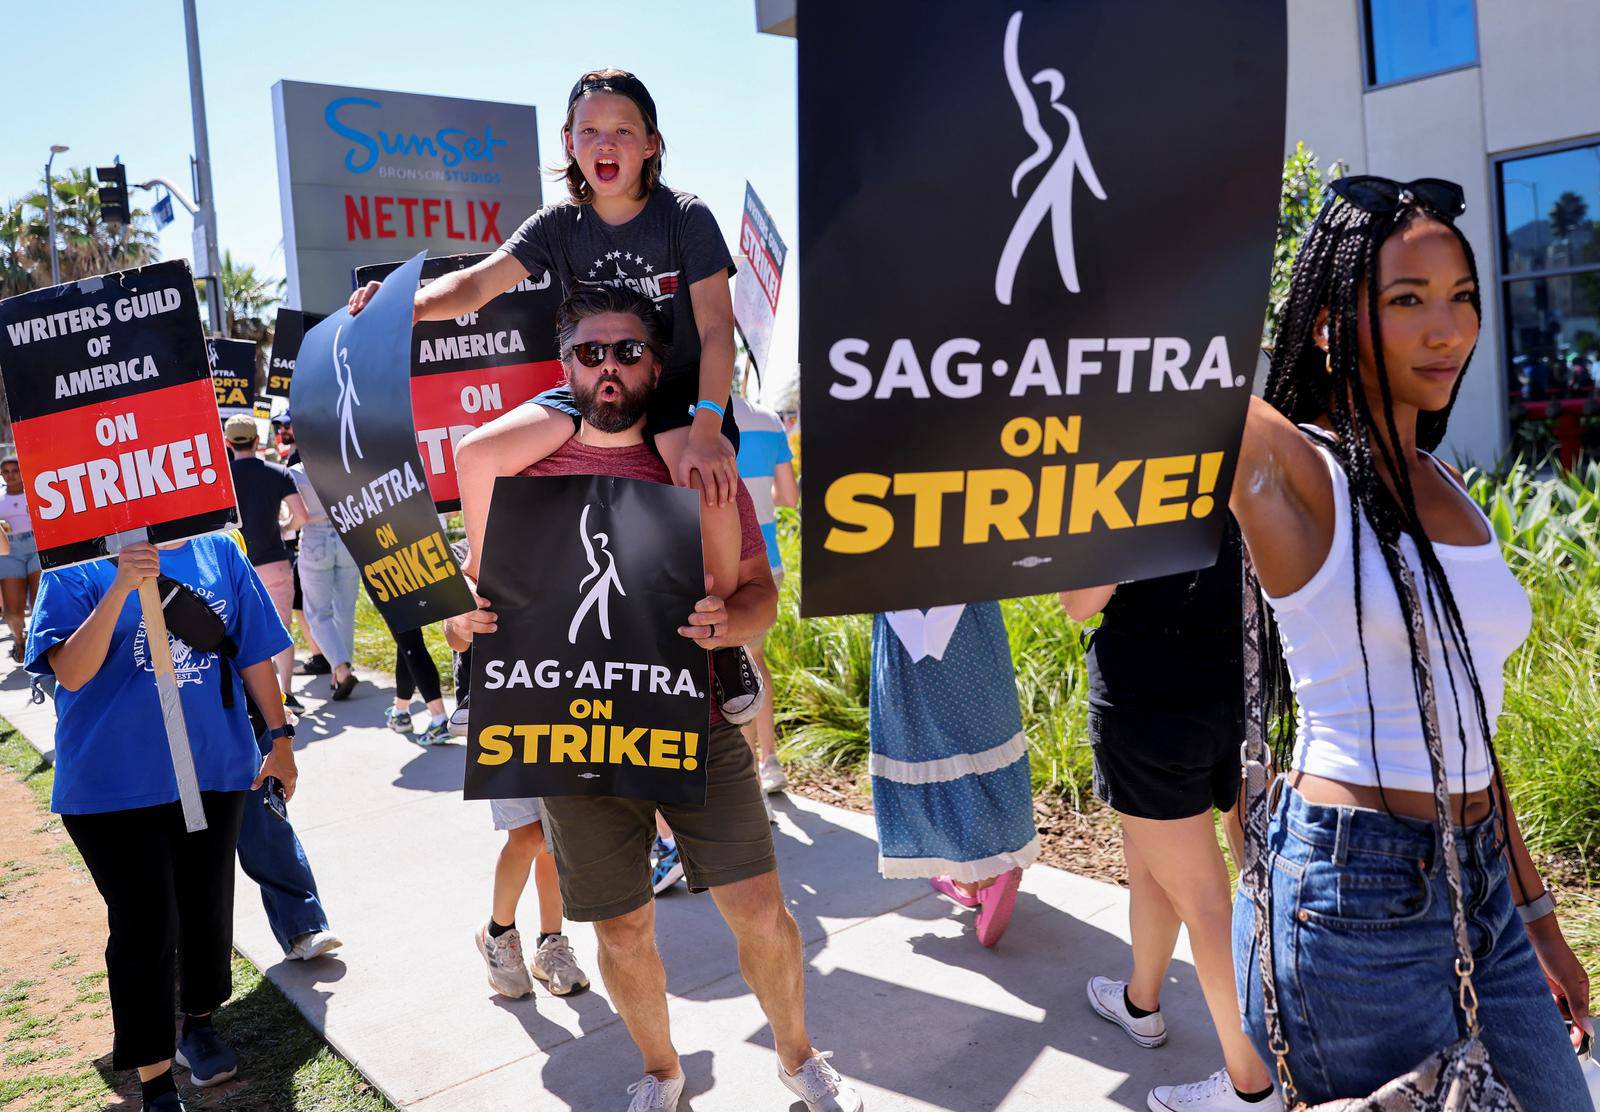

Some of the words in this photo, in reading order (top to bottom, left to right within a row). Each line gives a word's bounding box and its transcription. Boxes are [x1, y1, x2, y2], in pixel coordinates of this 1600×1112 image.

[345, 194, 503, 244] NETFLIX
[6, 303, 111, 347] WRITERS
[114, 287, 182, 322] GUILD
[87, 335, 111, 358] OF
[419, 330, 526, 364] AMERICA
[55, 355, 160, 400] AMERICA
[460, 383, 503, 414] ON
[95, 412, 139, 447] ON
[1000, 415, 1082, 458] ON
[34, 433, 217, 520] STRIKE!
[823, 451, 1224, 554] STRIKE!
[375, 523, 398, 549] ON
[363, 531, 456, 602] STRIKE!
[569, 699, 613, 720] ON
[477, 725, 699, 771] STRIKE!
